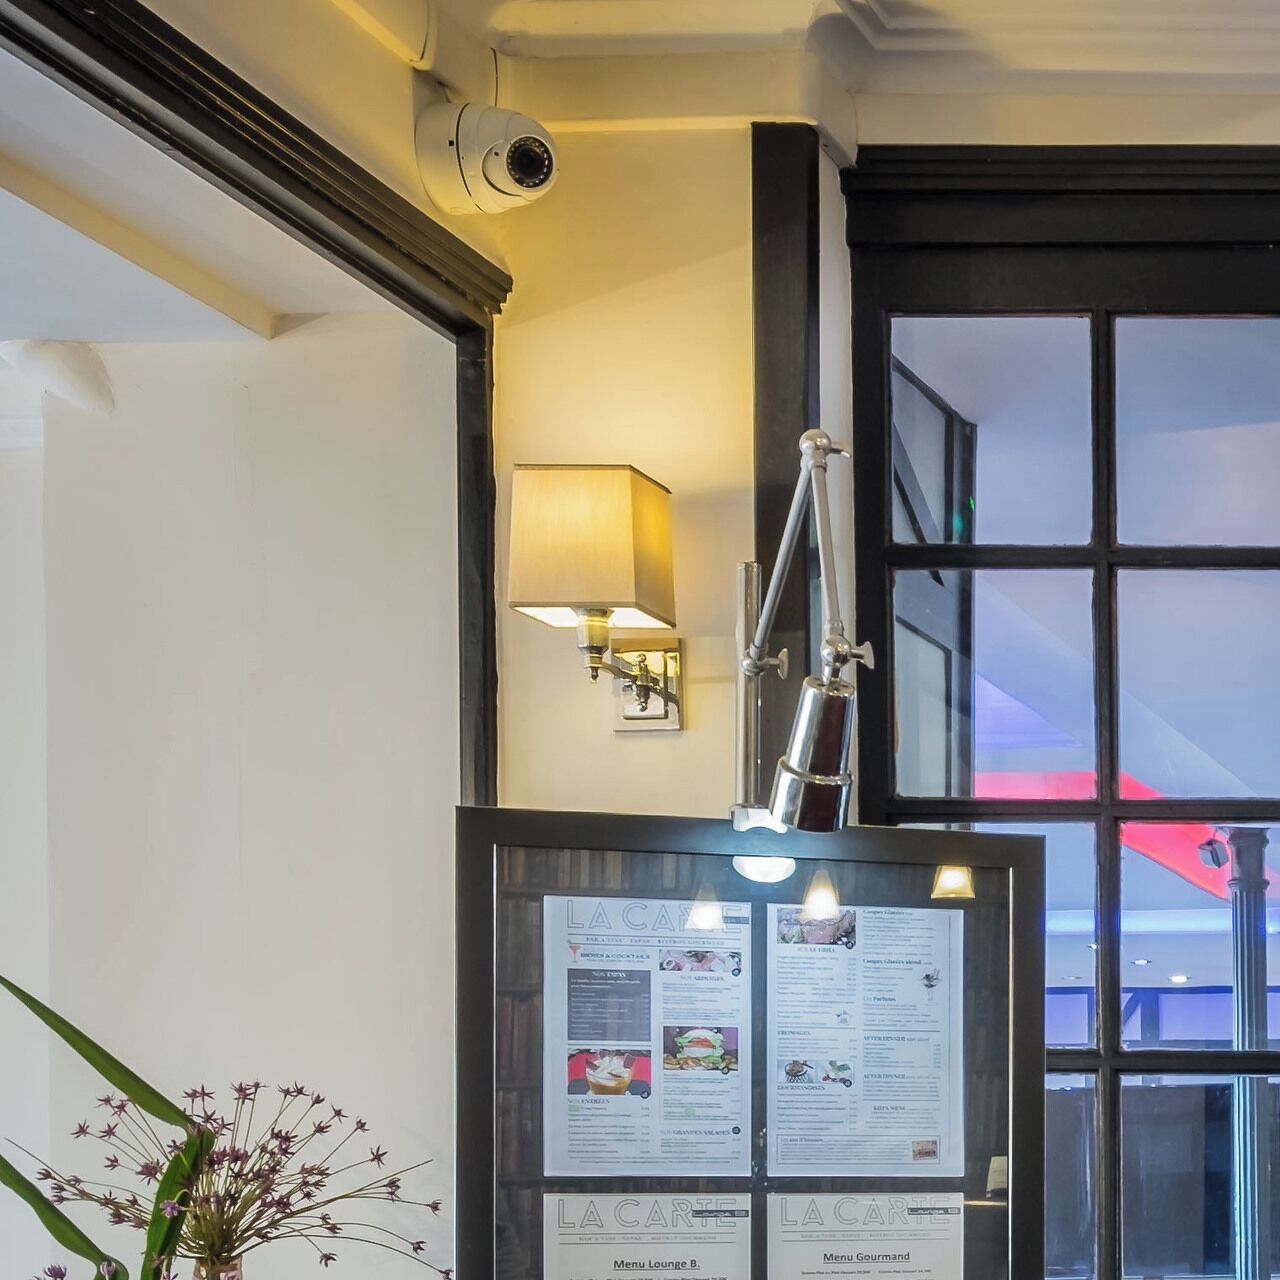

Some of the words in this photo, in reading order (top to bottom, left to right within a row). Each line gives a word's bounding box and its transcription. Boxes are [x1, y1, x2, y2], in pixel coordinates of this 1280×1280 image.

[567, 899, 612, 929] LA
[558, 1199, 604, 1228] LA
[614, 1198, 737, 1228] CARTE
[781, 1197, 824, 1226] LA
[833, 1196, 950, 1225] CARTE
[613, 1260, 646, 1269] Menu
[648, 1260, 688, 1271] Lounge
[690, 1260, 701, 1269] B.
[823, 1253, 854, 1262] Menu
[856, 1252, 911, 1262] Gourmand
